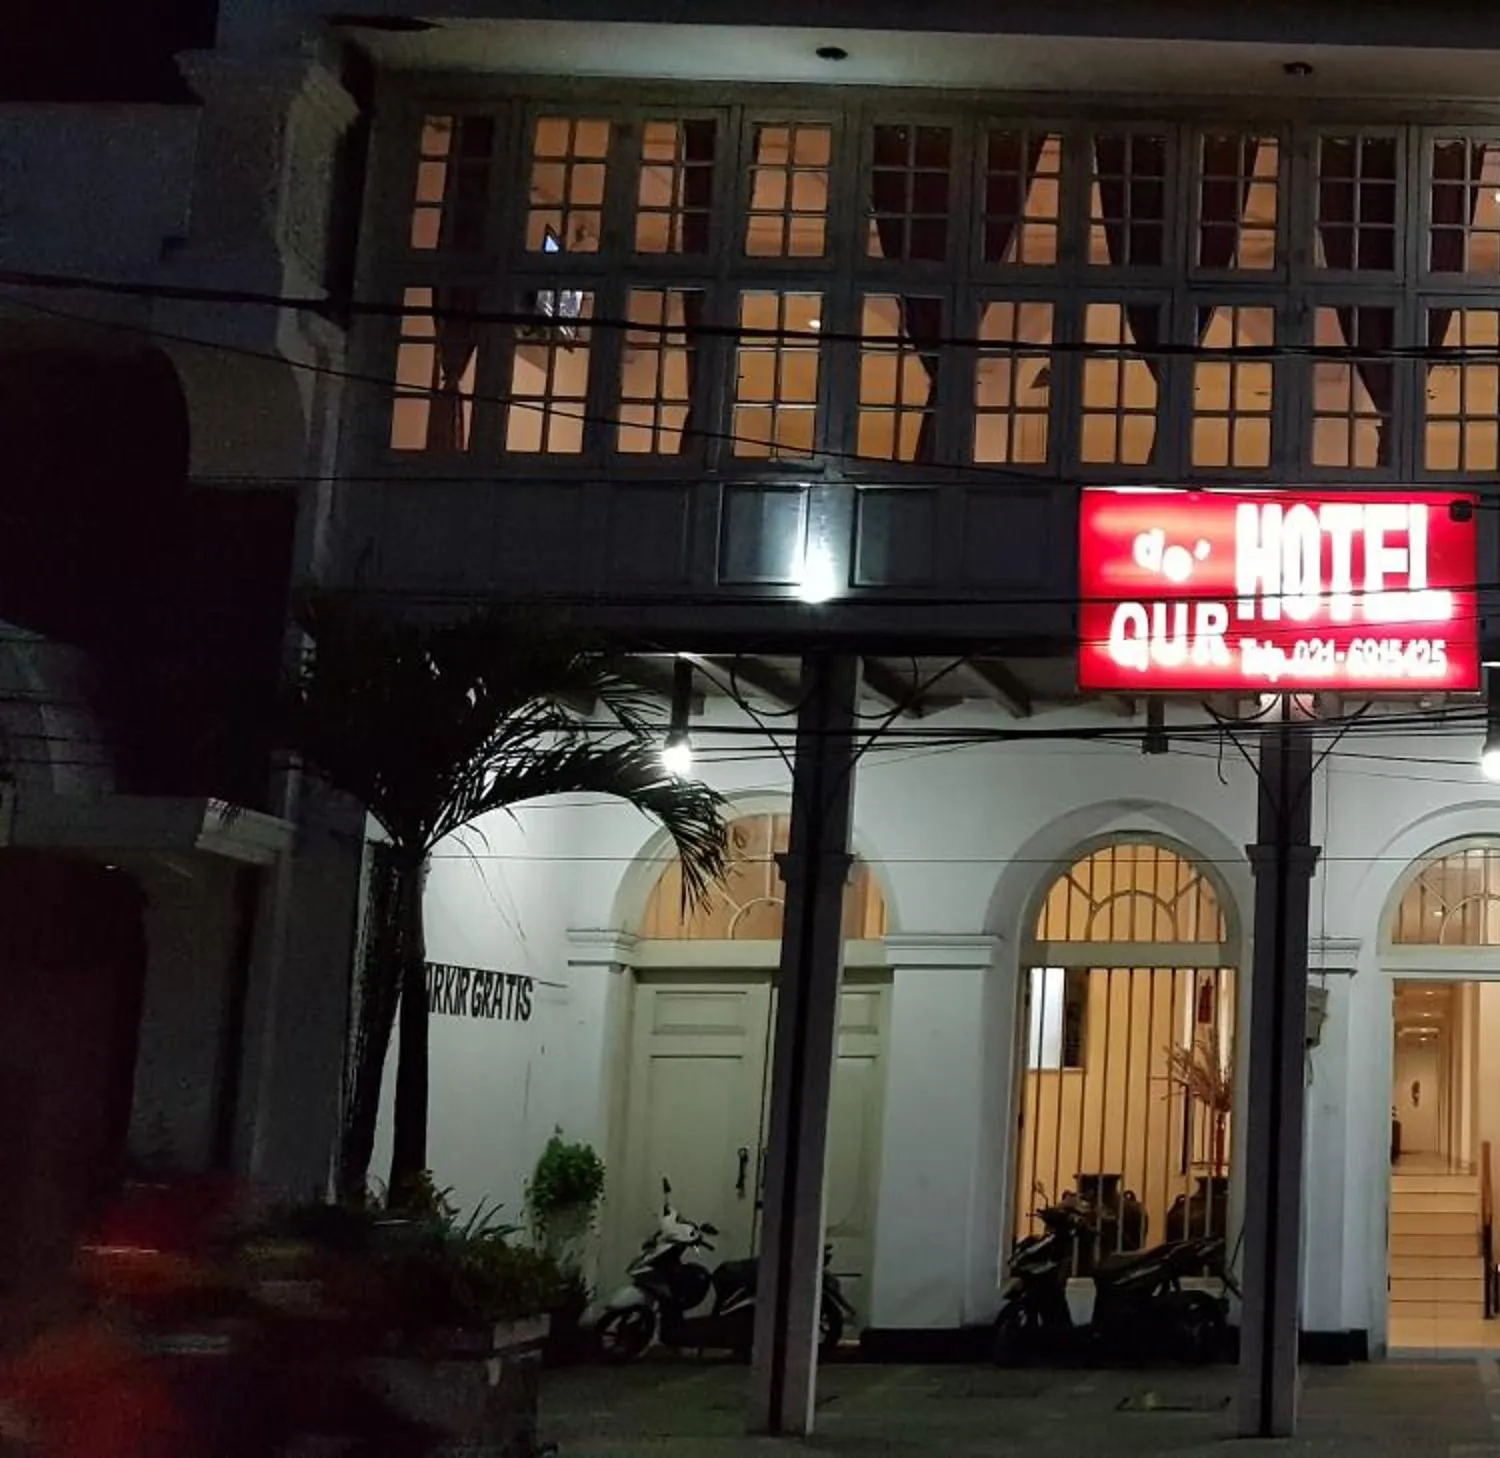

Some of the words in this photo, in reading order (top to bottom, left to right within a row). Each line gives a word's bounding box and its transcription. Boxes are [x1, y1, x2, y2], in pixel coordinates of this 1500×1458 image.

[1236, 503, 1453, 620] HOTEL
[1110, 602, 1231, 671] QUR
[424, 962, 470, 1016] ARKIR
[471, 967, 533, 1021] GRATIS
